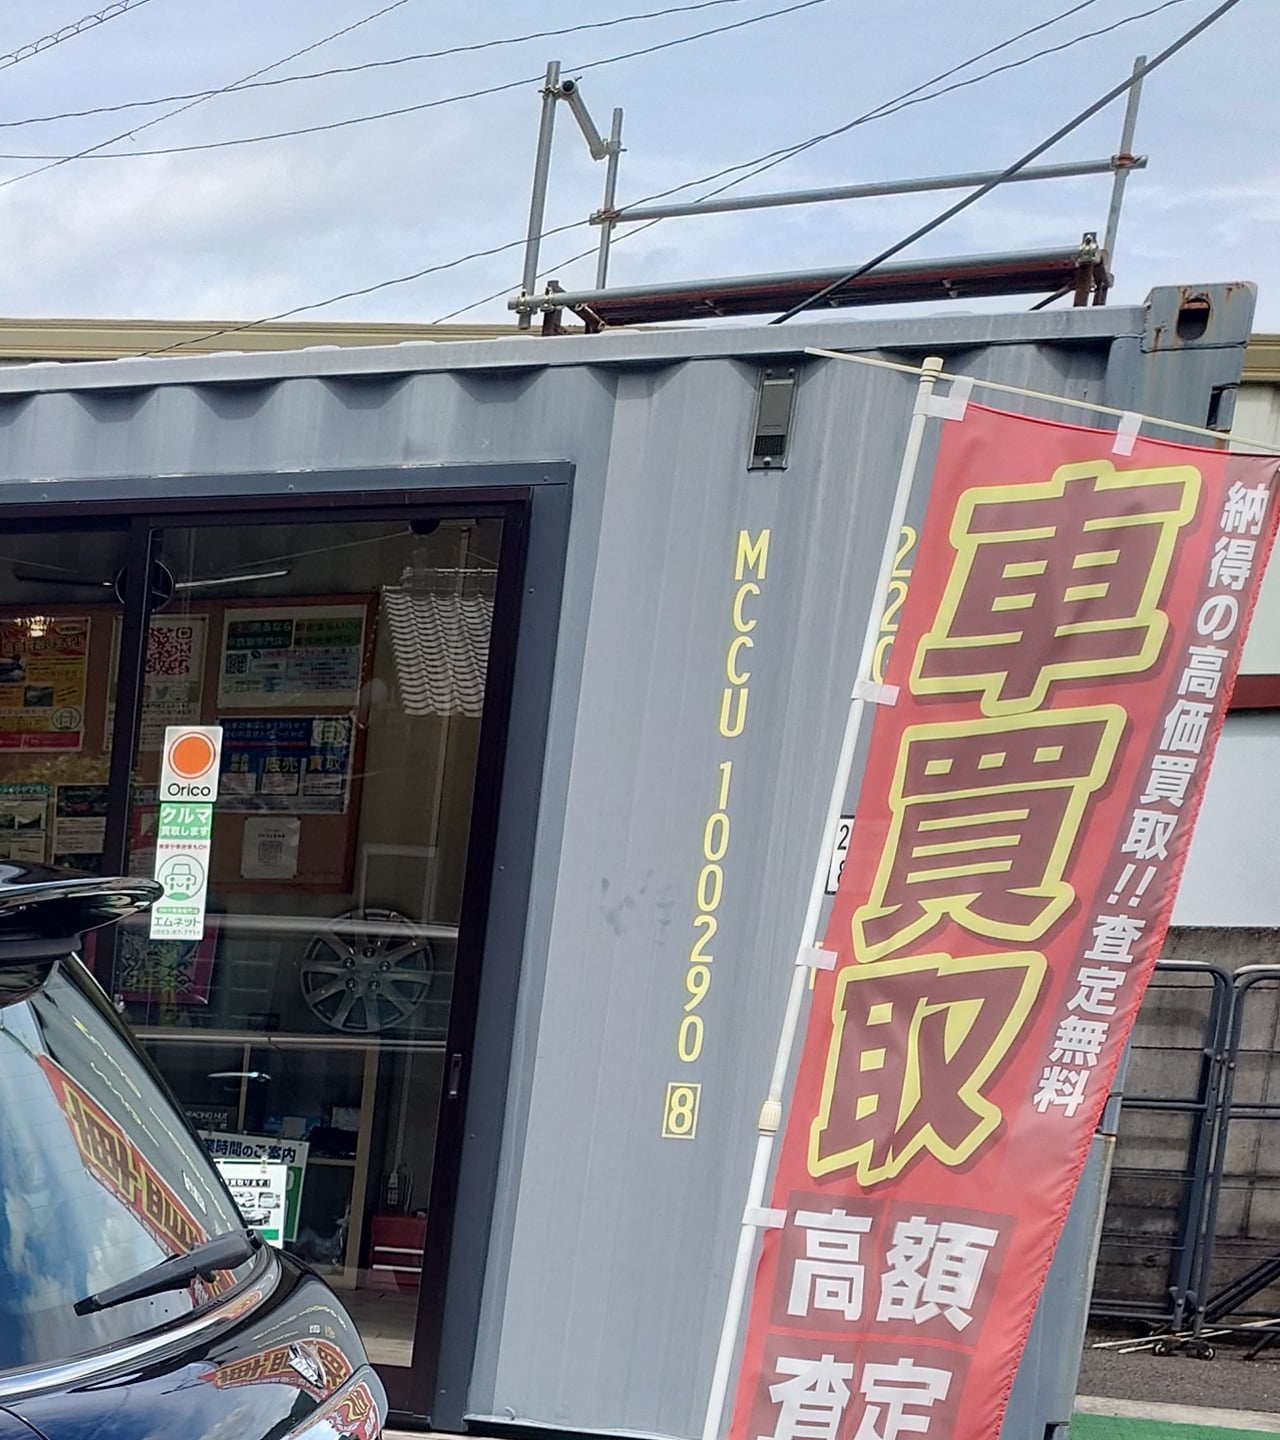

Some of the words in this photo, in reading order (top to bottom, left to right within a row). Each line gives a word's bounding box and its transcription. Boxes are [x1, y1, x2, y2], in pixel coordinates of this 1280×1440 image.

[719, 528, 771, 738] MCCU
[167, 782, 211, 797] Orico
[160, 826, 209, 836] 買取します
[161, 806, 211, 825] クルマ
[808, 460, 1202, 1186] 車買取
[154, 917, 200, 927] エムネット
[677, 760, 732, 1063] 100290
[666, 1086, 698, 1136] 8
[786, 1206, 999, 1333] 高額
